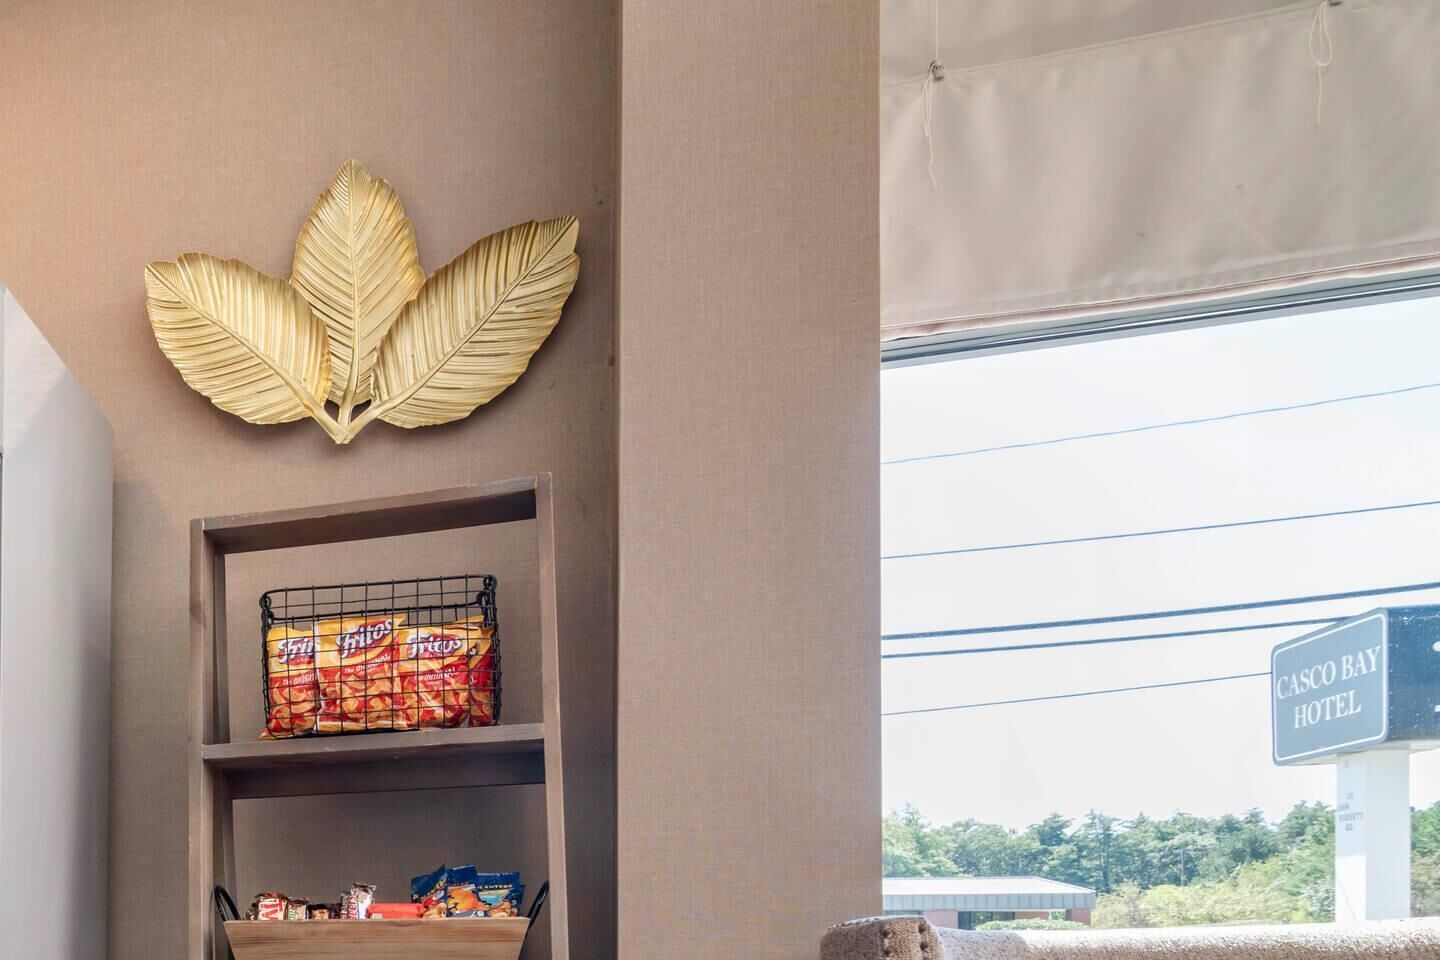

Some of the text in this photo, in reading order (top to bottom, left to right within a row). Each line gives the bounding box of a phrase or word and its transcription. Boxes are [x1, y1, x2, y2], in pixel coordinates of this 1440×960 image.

[336, 619, 393, 659] Fritos
[407, 632, 462, 660] Fritos
[1277, 645, 1382, 699] CASCO BAY
[1294, 690, 1362, 729] HOTEL
